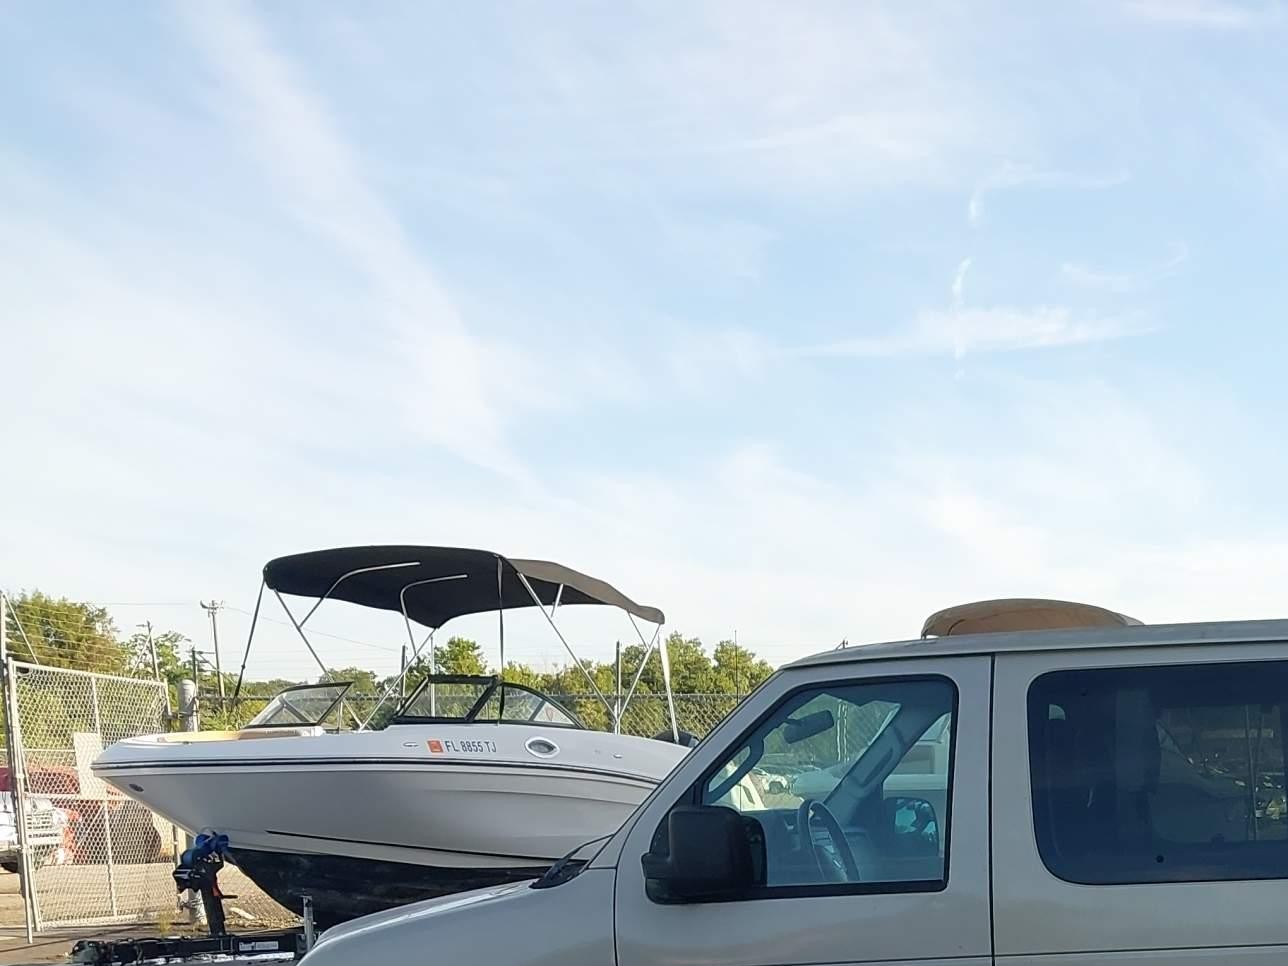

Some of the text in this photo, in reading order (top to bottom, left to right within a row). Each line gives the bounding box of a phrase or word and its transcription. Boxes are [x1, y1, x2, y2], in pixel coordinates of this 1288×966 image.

[444, 740, 497, 753] FL 8855 TJ
